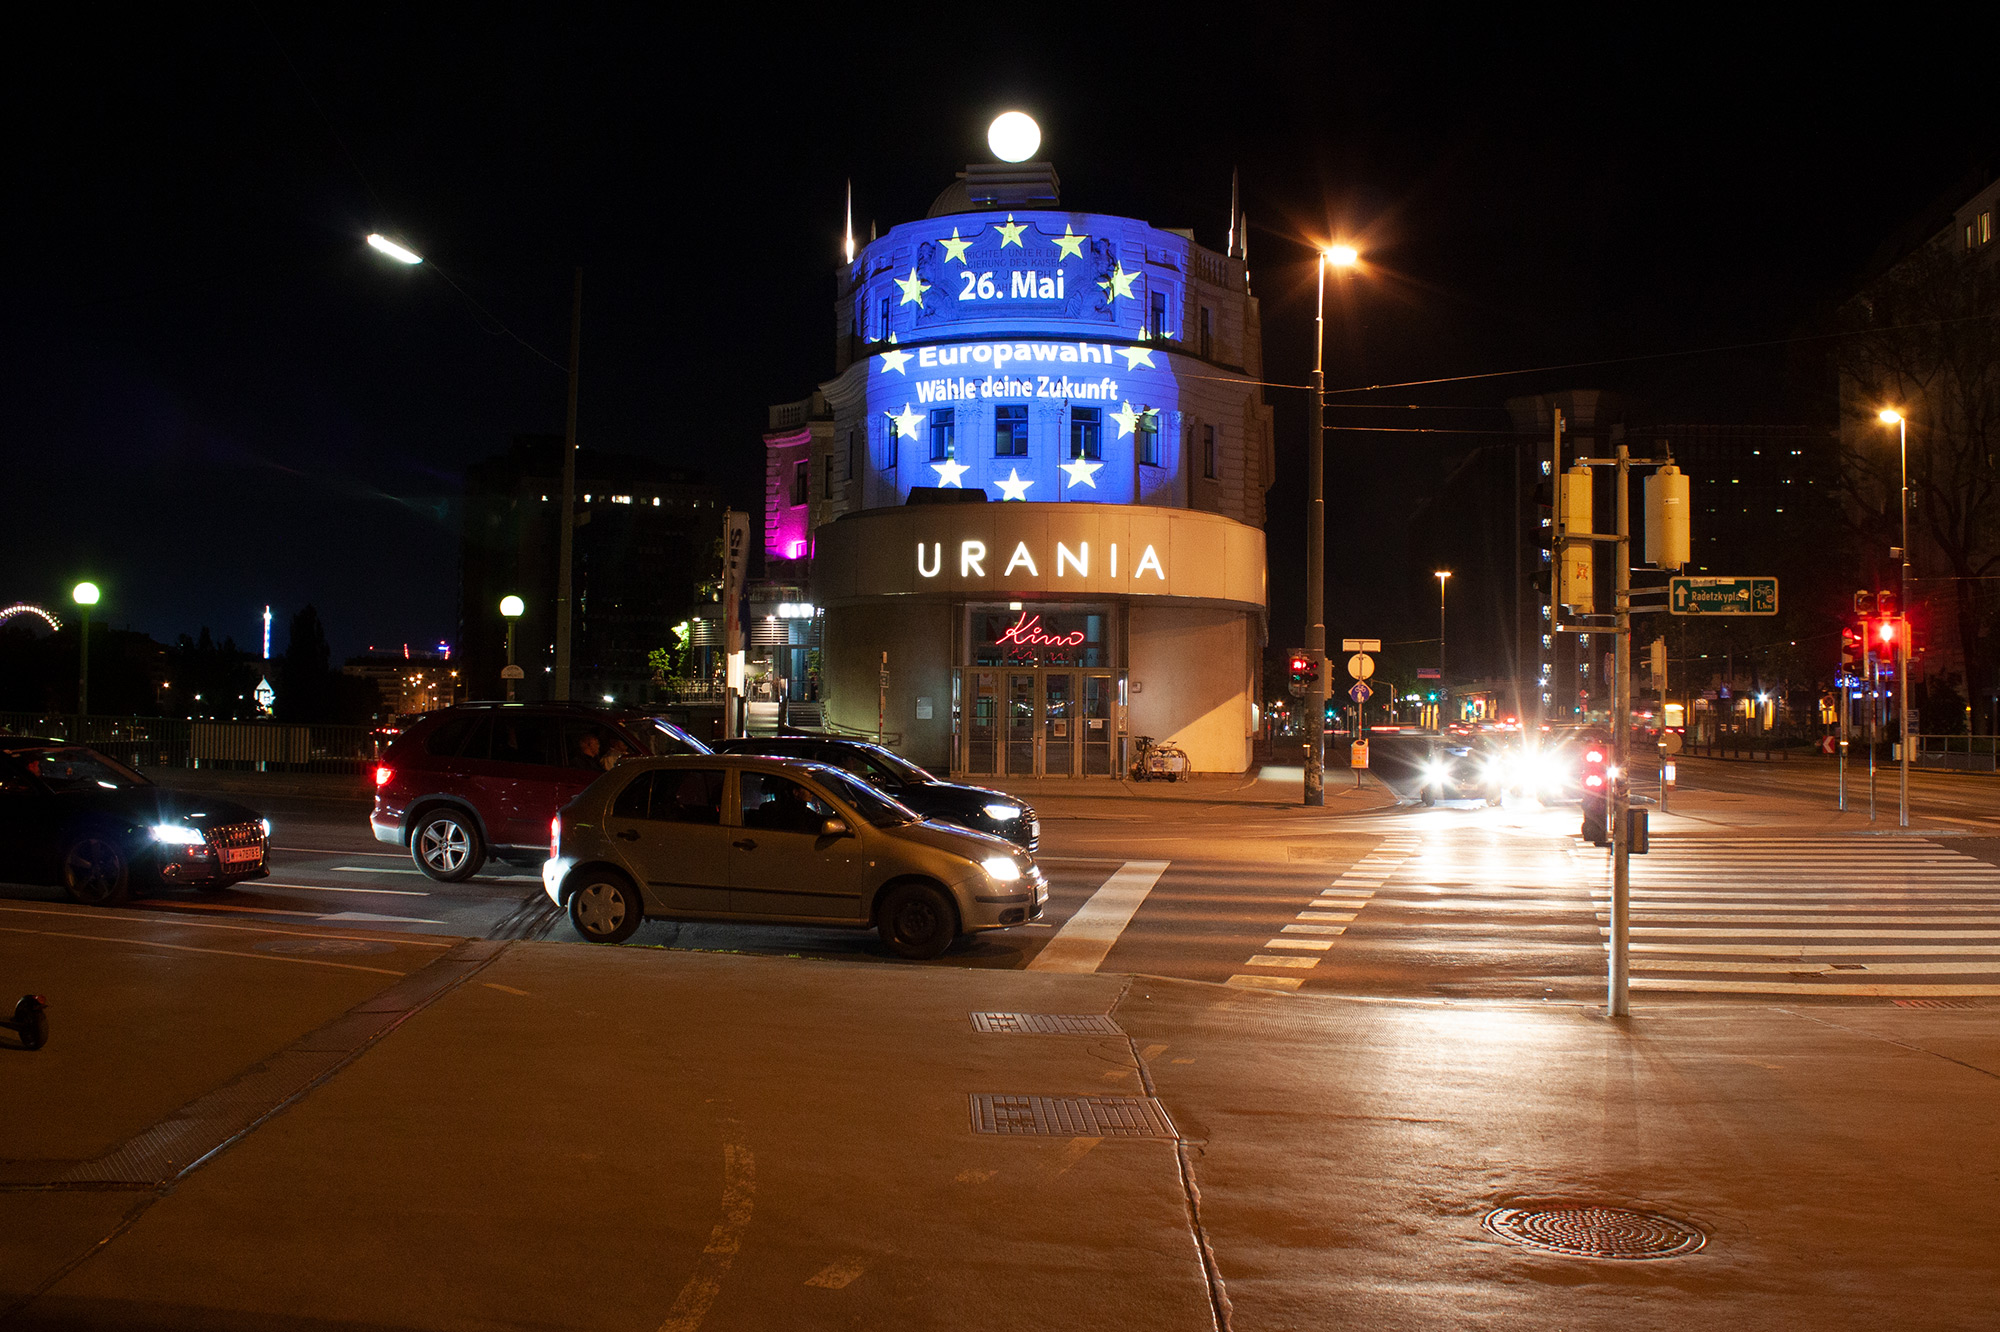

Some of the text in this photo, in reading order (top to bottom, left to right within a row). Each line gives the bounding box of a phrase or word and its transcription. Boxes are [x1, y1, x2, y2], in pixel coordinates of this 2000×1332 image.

[1009, 258, 1028, 267] DES
[959, 268, 1064, 301] 26. Mai
[919, 342, 1113, 369] Europawahl
[916, 375, 1119, 403] Wähle deine Zukunft
[917, 541, 1165, 579] URANIA
[1691, 591, 1749, 603] Radetzkypla
[996, 611, 1084, 646] Kino
